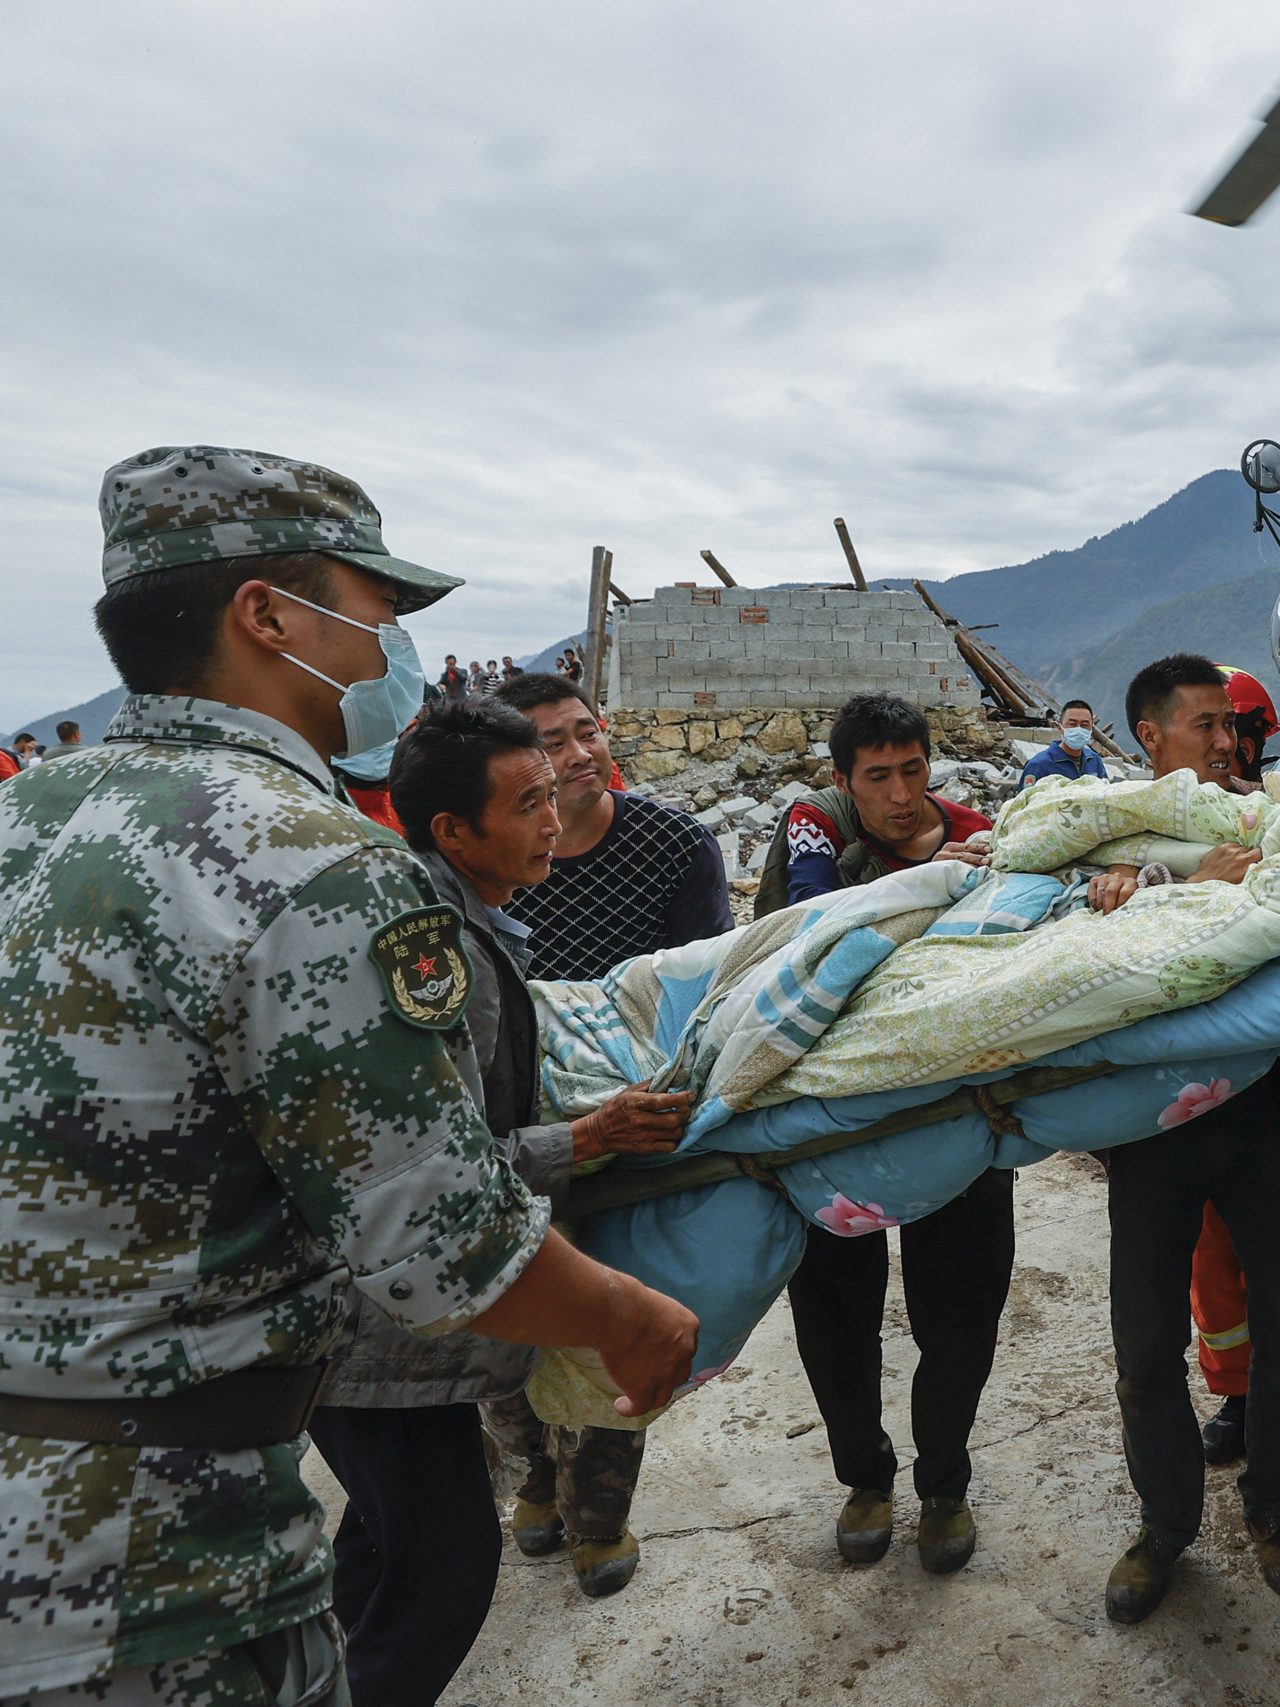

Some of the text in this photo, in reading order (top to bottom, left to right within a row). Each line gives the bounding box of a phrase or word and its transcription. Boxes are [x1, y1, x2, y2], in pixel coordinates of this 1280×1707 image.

[377, 914, 452, 951] 中国人民解放军
